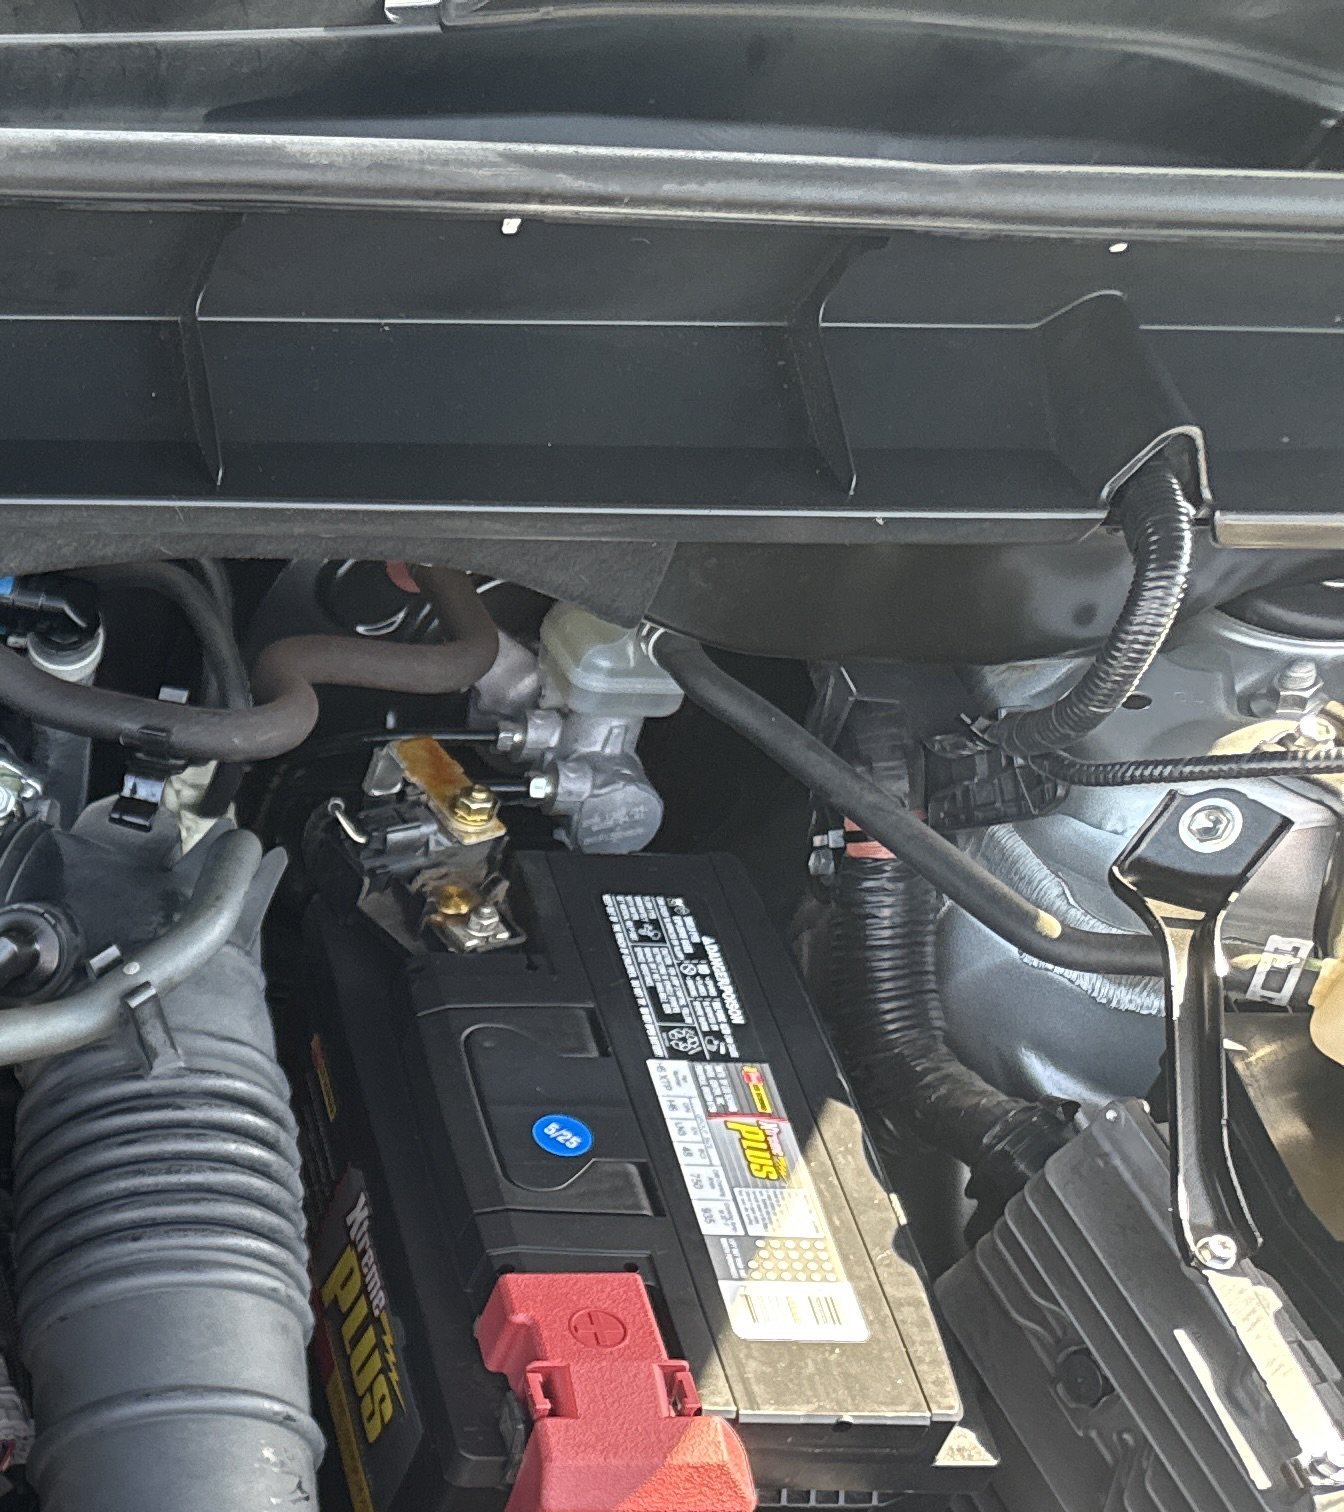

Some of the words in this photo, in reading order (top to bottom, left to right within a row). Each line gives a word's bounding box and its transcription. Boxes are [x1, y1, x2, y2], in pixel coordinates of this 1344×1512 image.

[543, 1121, 582, 1149] 5/25
[725, 1120, 780, 1181] PLUS
[689, 1173, 703, 1190] 750
[346, 1192, 385, 1318] Xtreme
[321, 1244, 394, 1444] PLUS
